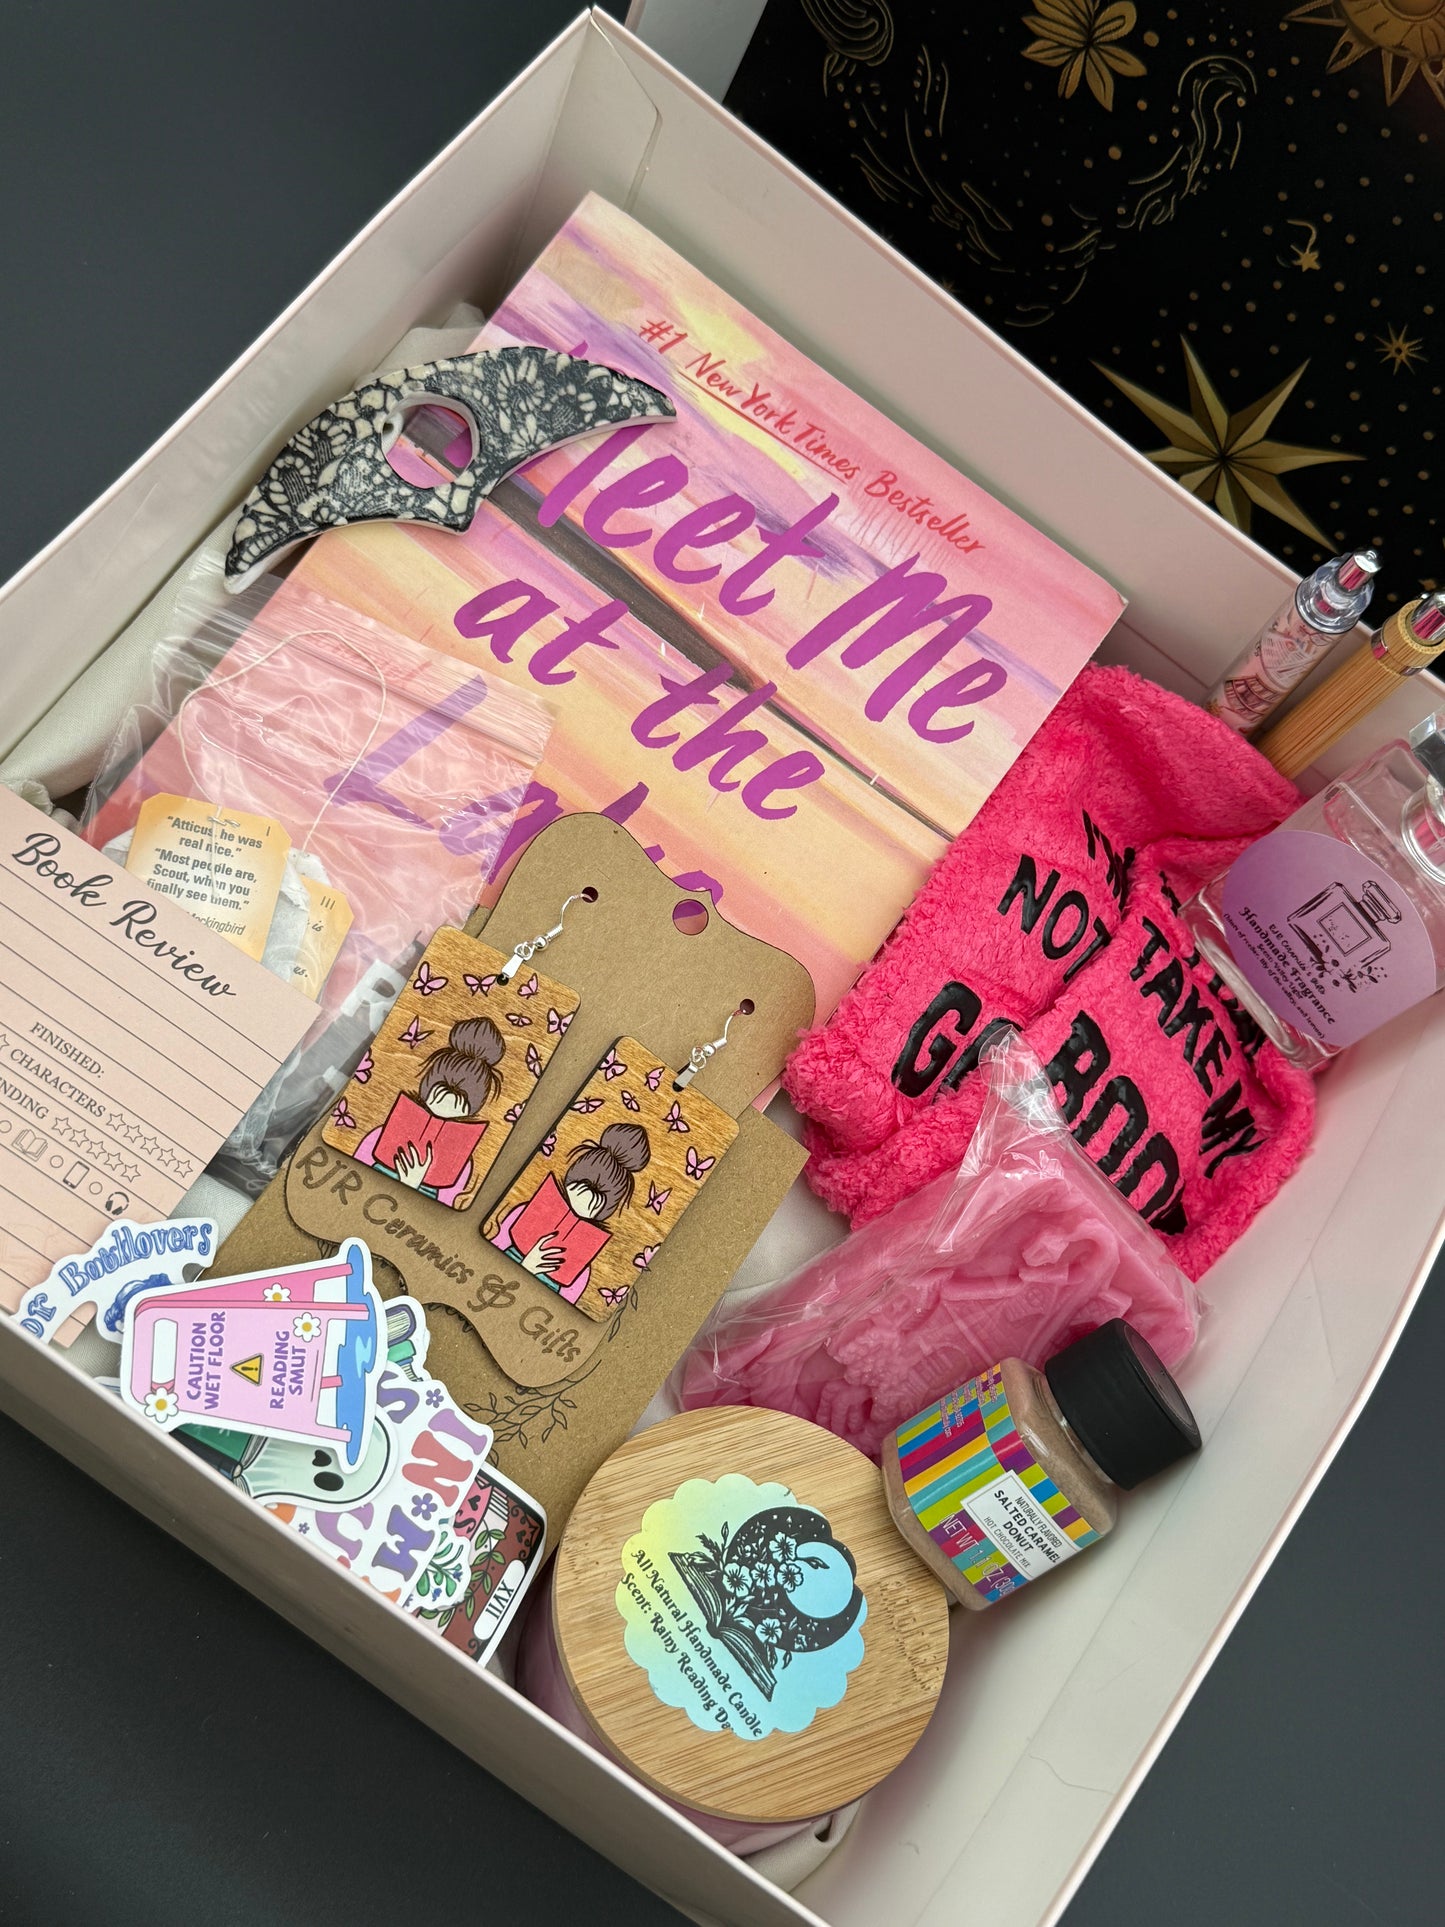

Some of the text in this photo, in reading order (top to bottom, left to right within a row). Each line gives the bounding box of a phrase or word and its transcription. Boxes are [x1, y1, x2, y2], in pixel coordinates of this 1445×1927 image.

[639, 319, 988, 555] #1 New York Times Bestseller
[785, 553, 1008, 744] Me
[453, 578, 826, 821] at the
[154, 847, 190, 868] "Most
[234, 867, 257, 883] are,
[179, 835, 203, 851] real
[220, 828, 235, 843] he
[237, 833, 263, 849] was
[12, 832, 237, 997] Book Review
[147, 878, 184, 901] finally
[186, 887, 208, 902] see
[152, 863, 191, 884] Scout,
[228, 882, 250, 898] you
[997, 854, 1111, 983] NOT
[1241, 907, 1335, 1024] Handmade Fragrance
[9, 1048, 107, 1118] CHARACTERS
[29, 1022, 105, 1078] FINISHED:
[1130, 916, 1231, 1098] TAKE
[1199, 1087, 1267, 1179] MY
[0, 1077, 49, 1119] NDING
[296, 1147, 581, 1363] RJR Ceramics & Gifts
[187, 1321, 207, 1400] CAUTION
[204, 1310, 226, 1410] WET FLOOR
[269, 1330, 290, 1409] READING
[289, 1345, 307, 1396] SMUT
[402, 1409, 487, 1507] IN
[940, 1513, 965, 1538] NET
[955, 1533, 978, 1554] WT
[969, 1549, 989, 1568] 1.1
[982, 1561, 1004, 1582] OZ
[984, 1516, 1029, 1567] HOT CHOCOLATE MIX
[994, 1490, 1060, 1564] SALTED CARAMEL
[1003, 1520, 1033, 1552] DONUT
[1015, 1496, 1061, 1548] NATURALLY FLAVORED
[621, 1573, 735, 1732] Scent: Rainy Reading Da
[631, 1549, 762, 1737] All Natural Handmade Candle
